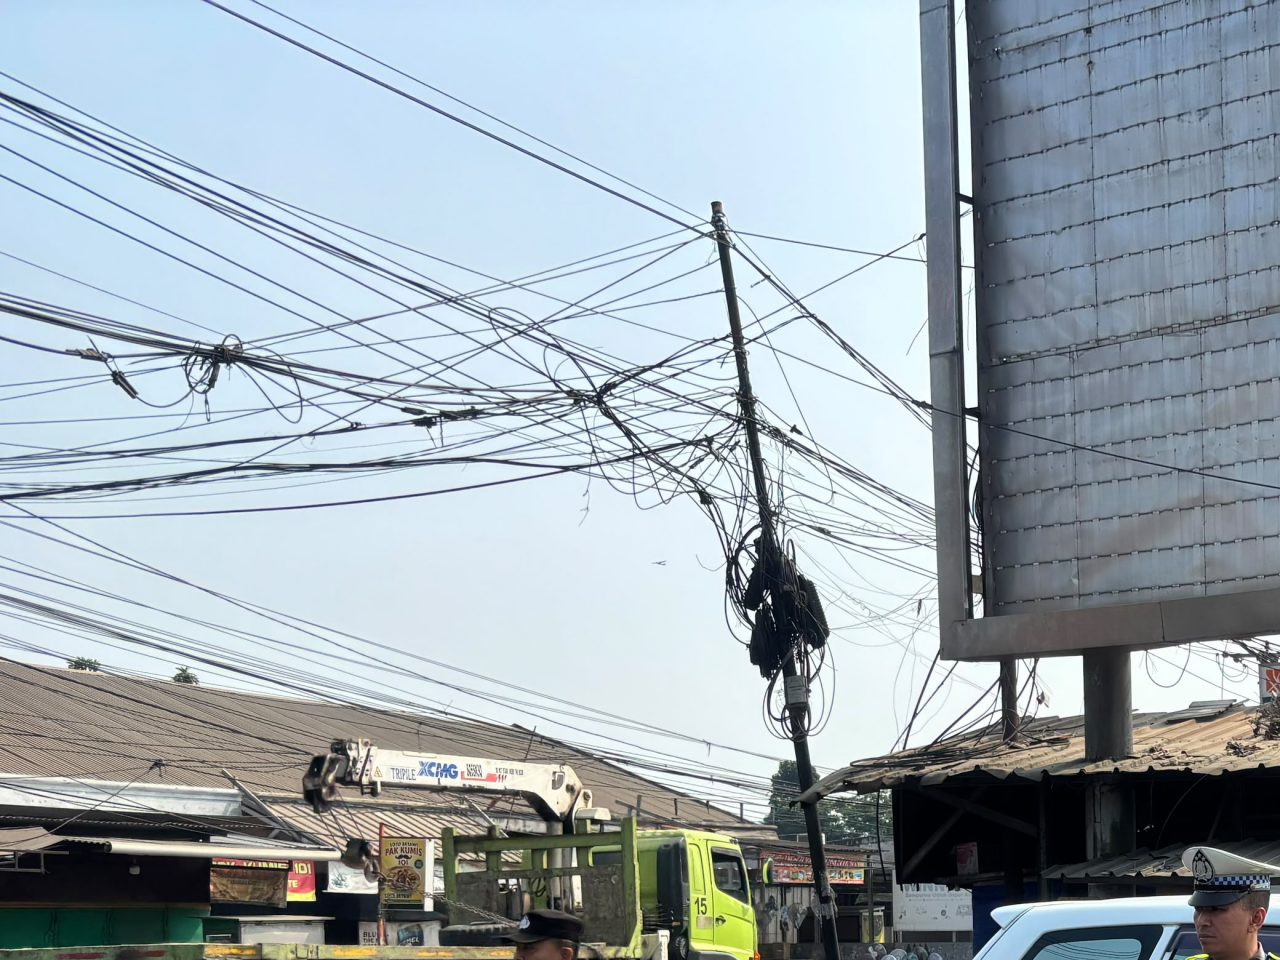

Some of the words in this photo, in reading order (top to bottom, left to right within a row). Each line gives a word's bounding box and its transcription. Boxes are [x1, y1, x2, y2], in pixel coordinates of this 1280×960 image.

[418, 761, 459, 779] XCMG
[385, 847, 399, 856] PAK
[400, 847, 423, 856] KUMIS
[694, 897, 708, 915] 15
